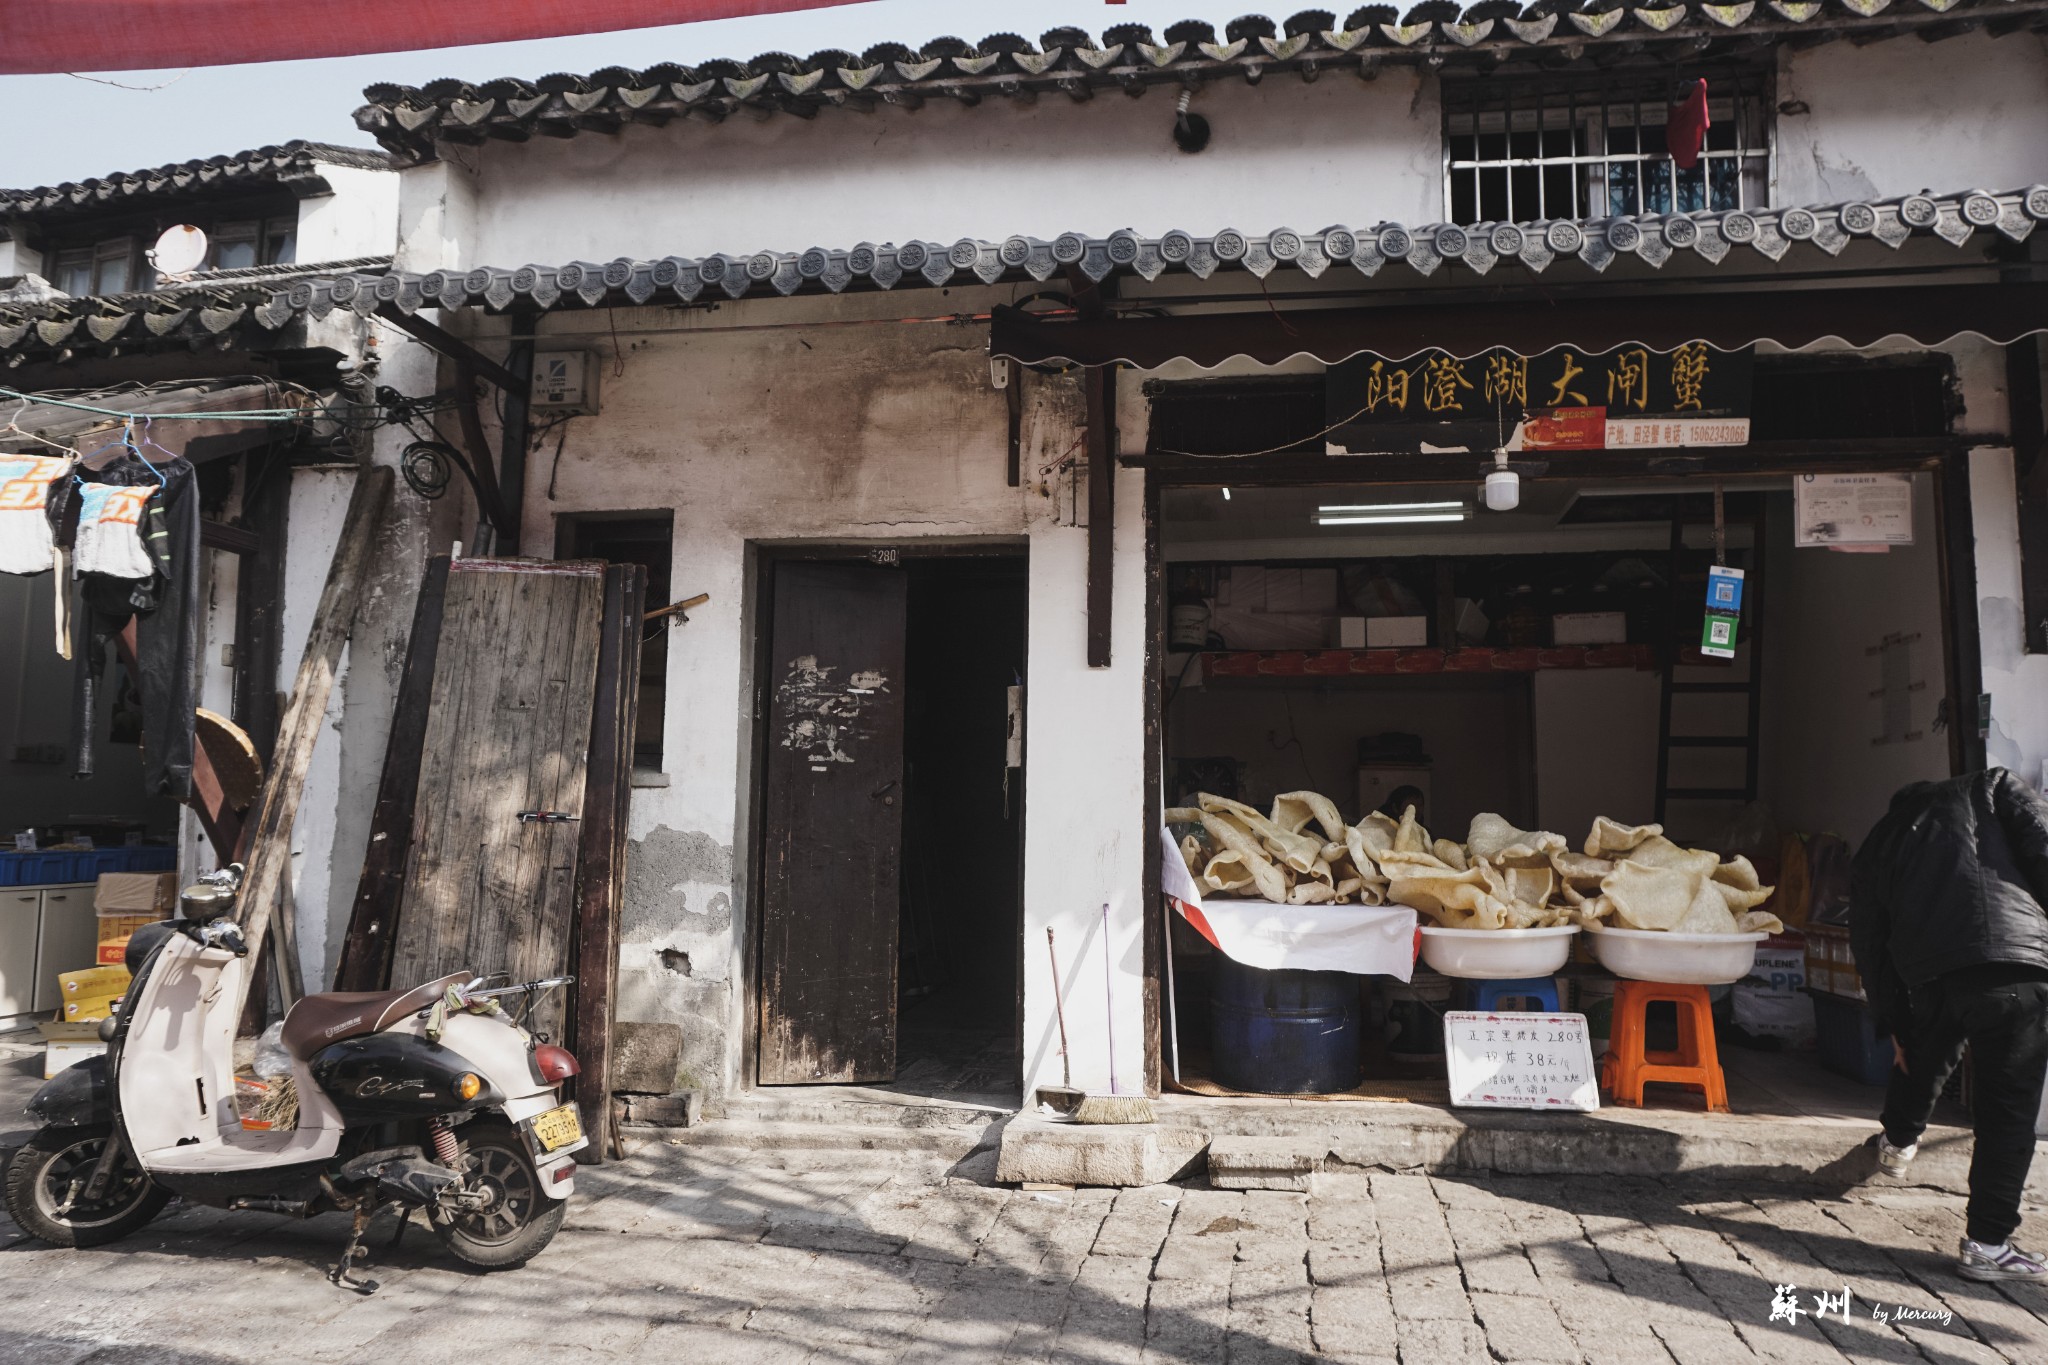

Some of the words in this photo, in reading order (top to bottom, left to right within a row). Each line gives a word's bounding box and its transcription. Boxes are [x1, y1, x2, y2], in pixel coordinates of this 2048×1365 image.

[1368, 342, 1711, 413] 阳澄湖大闸蟹
[1690, 425, 1746, 443] 15062343066
[878, 549, 896, 562] 280
[1771, 973, 1804, 992] PP
